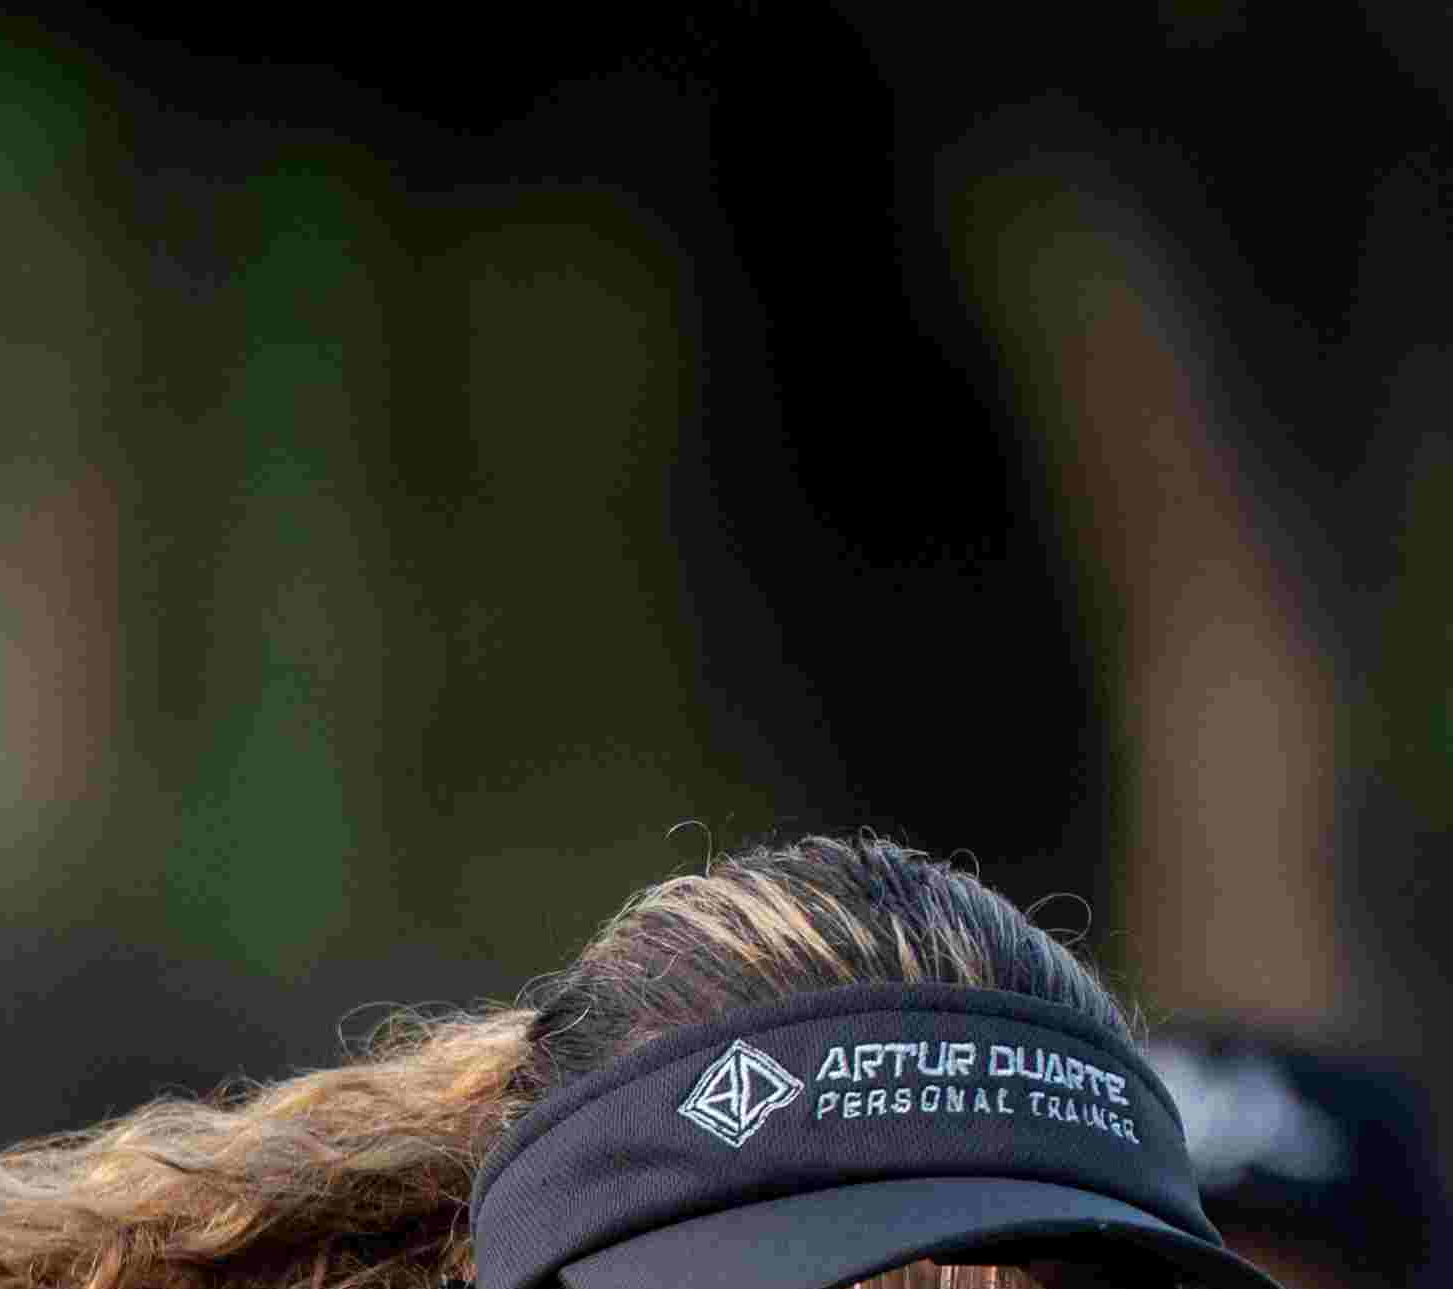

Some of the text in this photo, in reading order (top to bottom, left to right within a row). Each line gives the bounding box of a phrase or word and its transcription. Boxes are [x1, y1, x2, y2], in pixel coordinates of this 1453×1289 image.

[816, 1042, 1129, 1105] ARTUR DUARTE
[817, 1085, 1139, 1144] PERSONAL TRAINER
